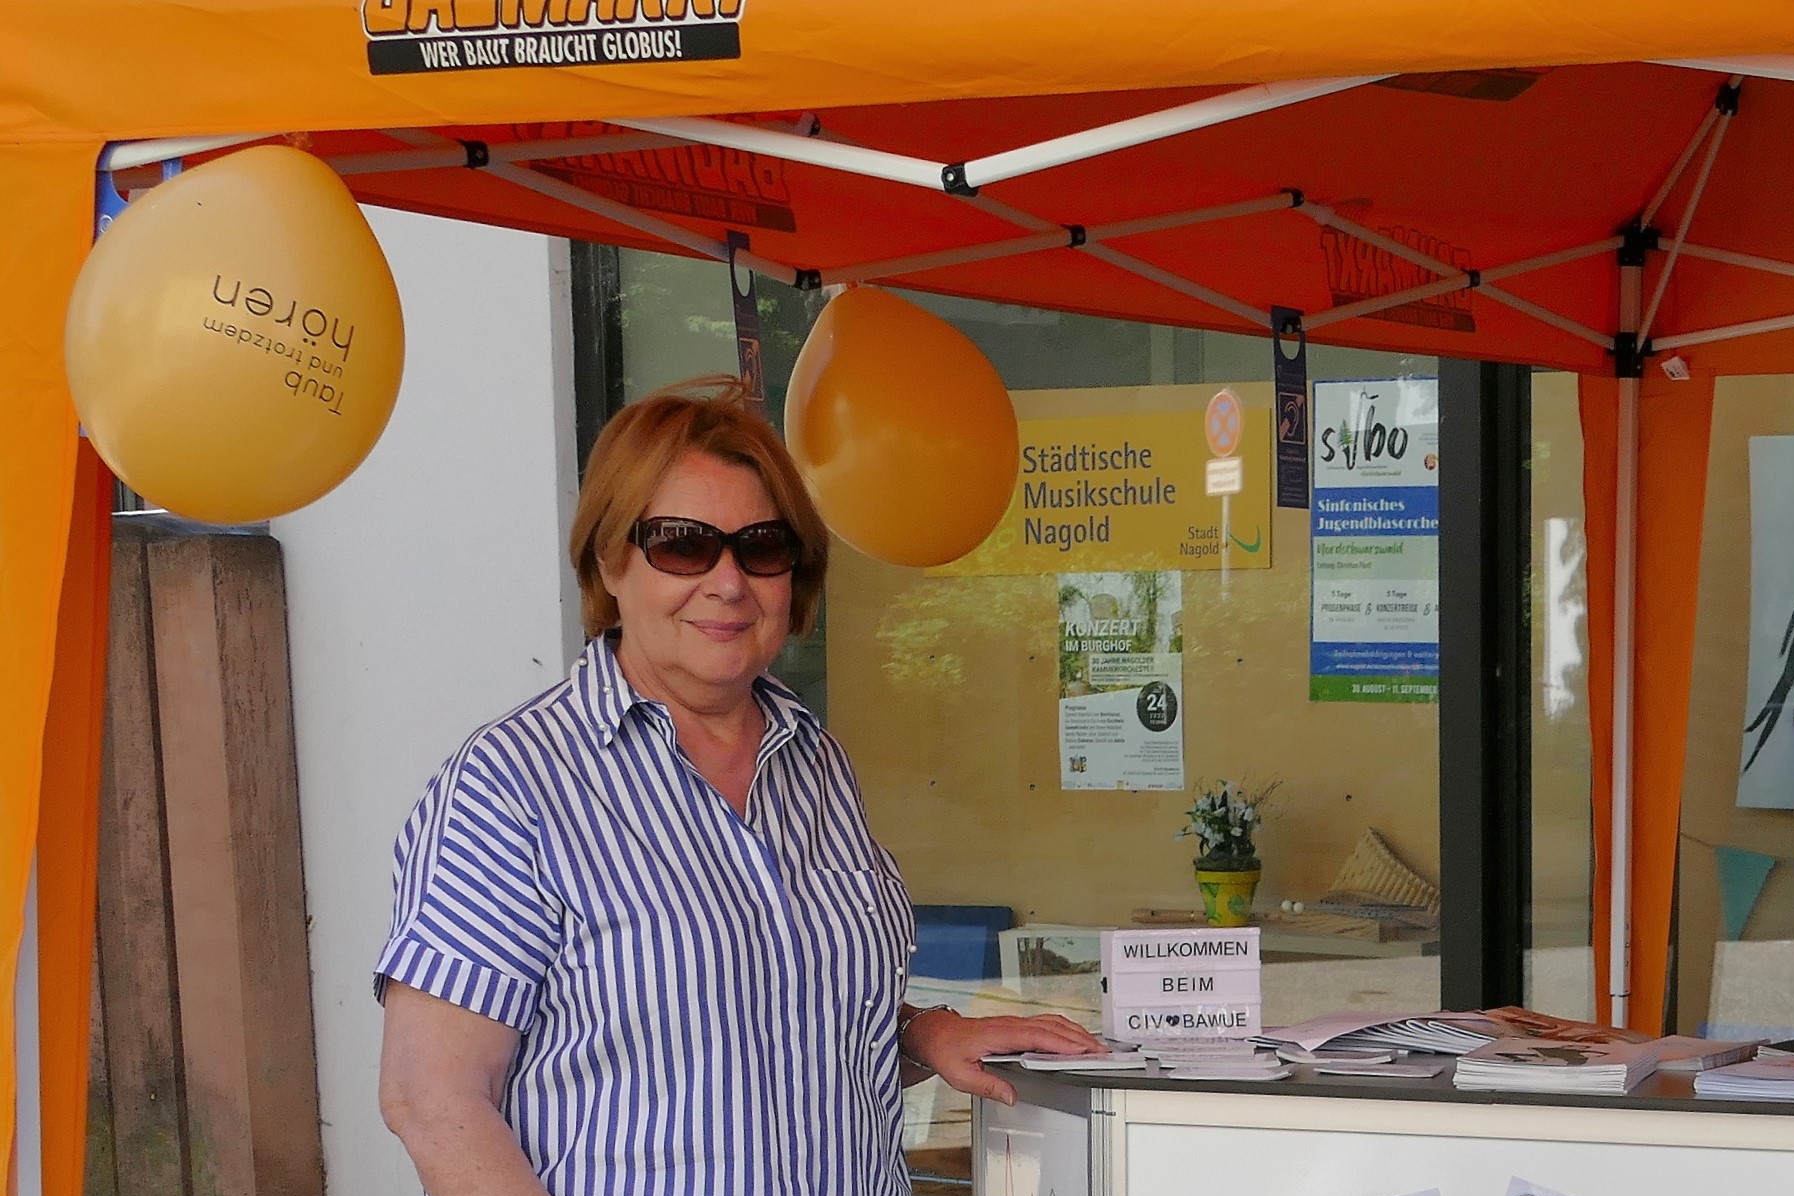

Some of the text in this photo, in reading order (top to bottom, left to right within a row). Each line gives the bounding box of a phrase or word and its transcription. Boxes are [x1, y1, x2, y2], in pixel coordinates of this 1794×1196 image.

[419, 30, 683, 69] WER BAUT BRAUCHT GLOBUS!
[213, 275, 354, 362] hören
[203, 317, 343, 378] und trotzdem
[285, 371, 344, 415] Taub
[1022, 441, 1152, 474] Städtische
[1023, 478, 1176, 509] Musikschule
[1317, 498, 1405, 512] Sinfonisches
[1024, 515, 1111, 552] Nagold
[1187, 526, 1219, 541] Stadt
[1179, 541, 1219, 557] Nagold
[1065, 619, 1141, 637] KONZERT
[1065, 640, 1132, 652] IM BURGHOF
[1123, 940, 1248, 958] WILLKOMMEN
[1161, 975, 1215, 993] BEIM
